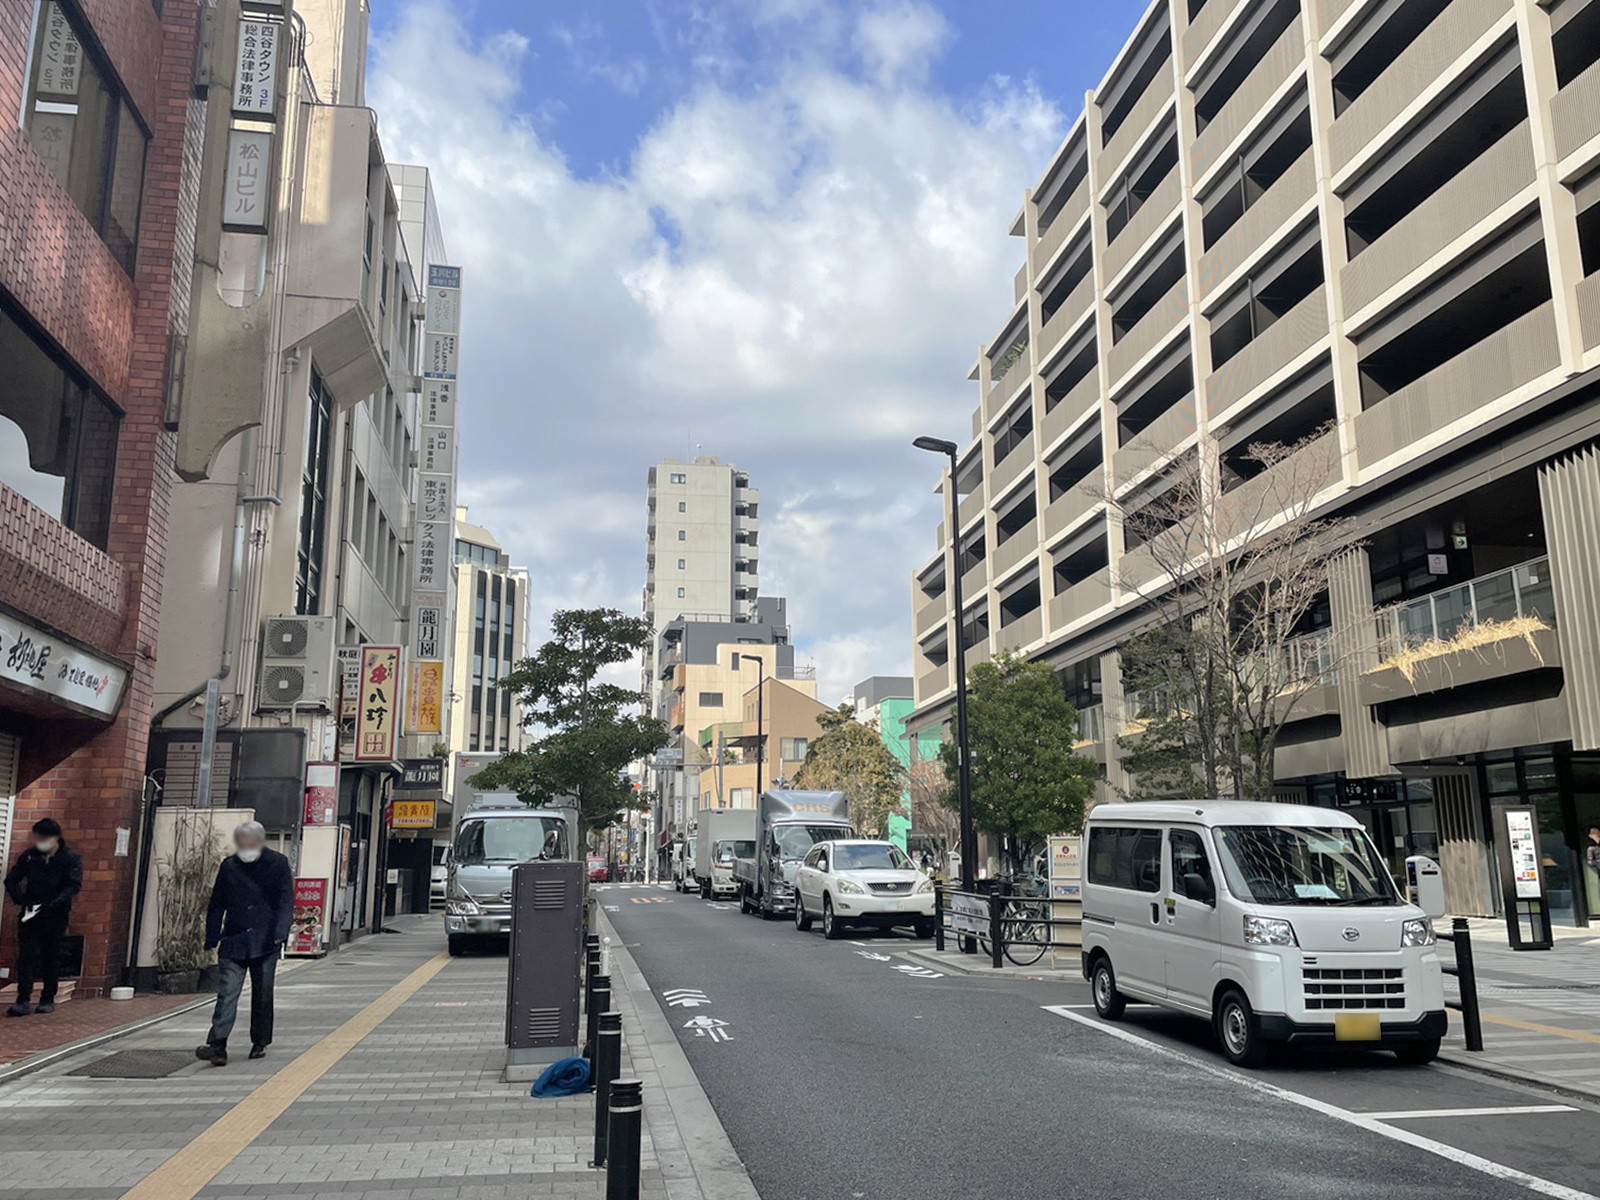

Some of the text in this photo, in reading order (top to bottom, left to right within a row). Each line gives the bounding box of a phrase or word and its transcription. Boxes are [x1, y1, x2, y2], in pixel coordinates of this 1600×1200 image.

[238, 24, 258, 107] 総合法律事務所
[258, 26, 274, 108] 四谷タウン 3F
[234, 143, 259, 214] 松山ビル
[438, 431, 447, 450] 山口
[419, 480, 438, 583] 東京フレックス法律事務所
[420, 609, 437, 657] 龍月園
